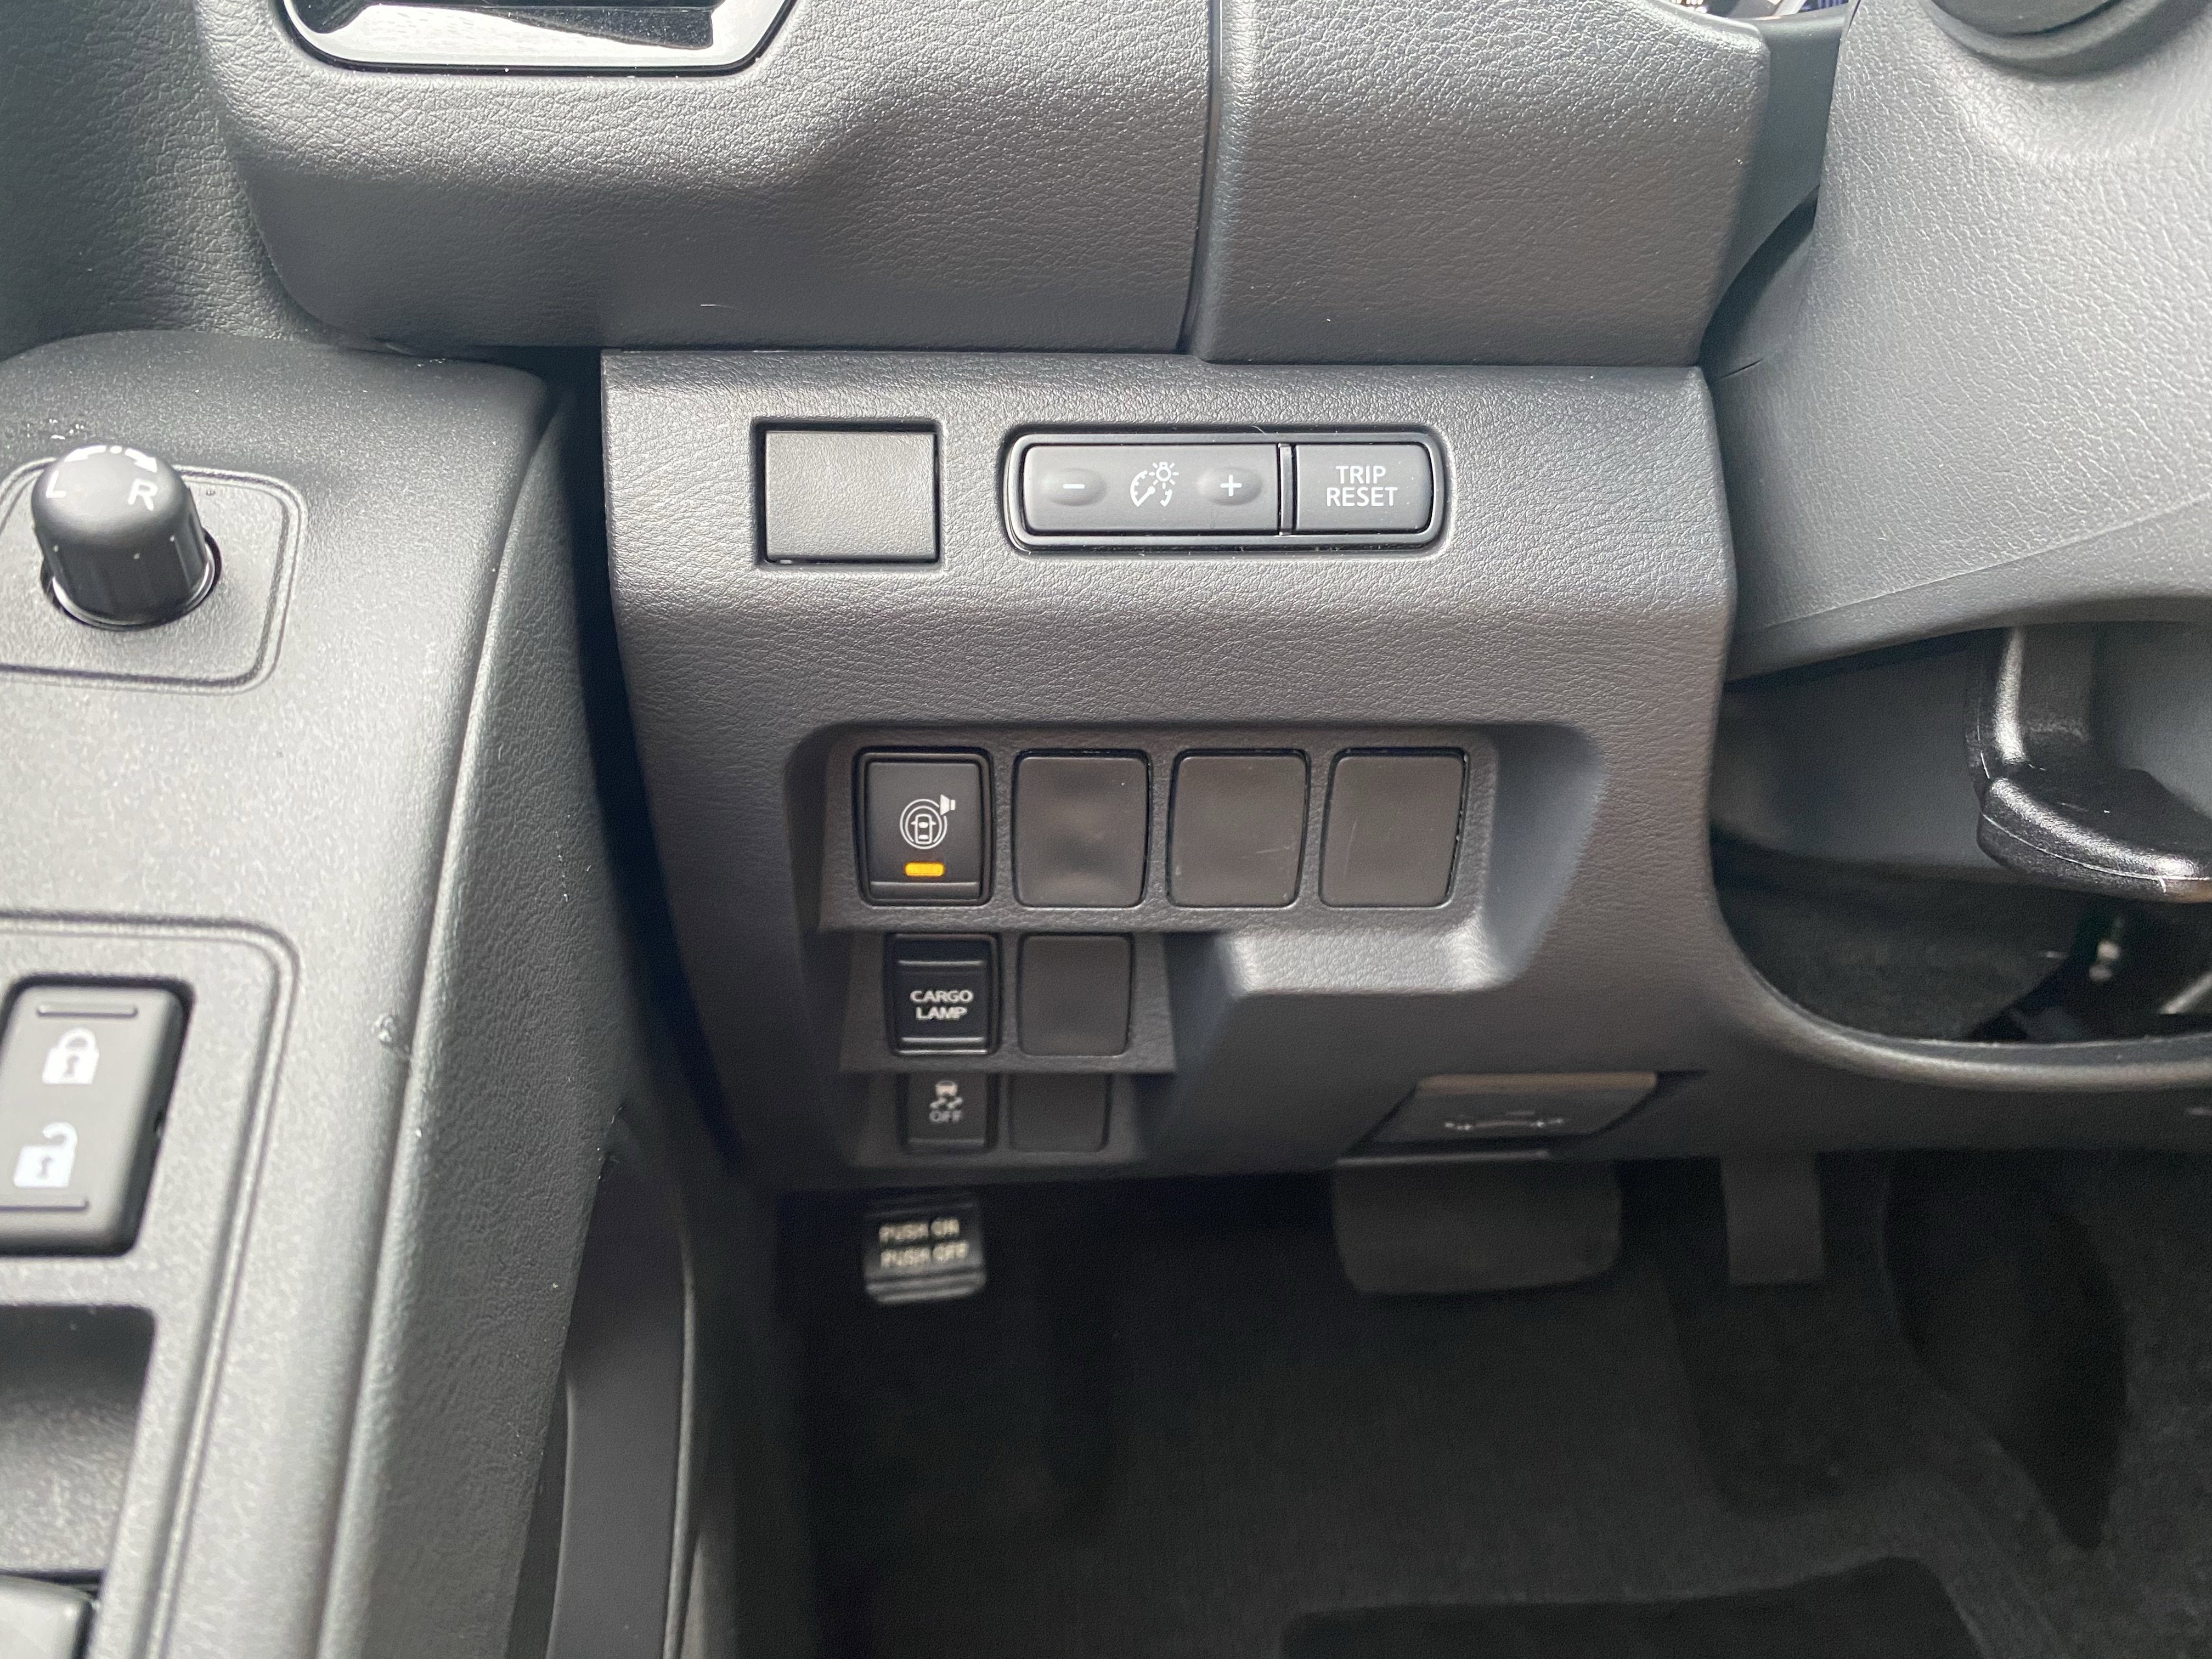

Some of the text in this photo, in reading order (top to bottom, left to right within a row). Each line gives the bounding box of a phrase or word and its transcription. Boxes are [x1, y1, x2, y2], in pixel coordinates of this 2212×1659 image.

[1335, 465, 1386, 484] TRIP
[46, 469, 159, 511] L R
[1327, 486, 1398, 507] RESET
[910, 989, 974, 1003] CARGO
[916, 1006, 968, 1020] LAMP
[879, 1222, 929, 1244] PUSH
[880, 1246, 931, 1269] PUSH
